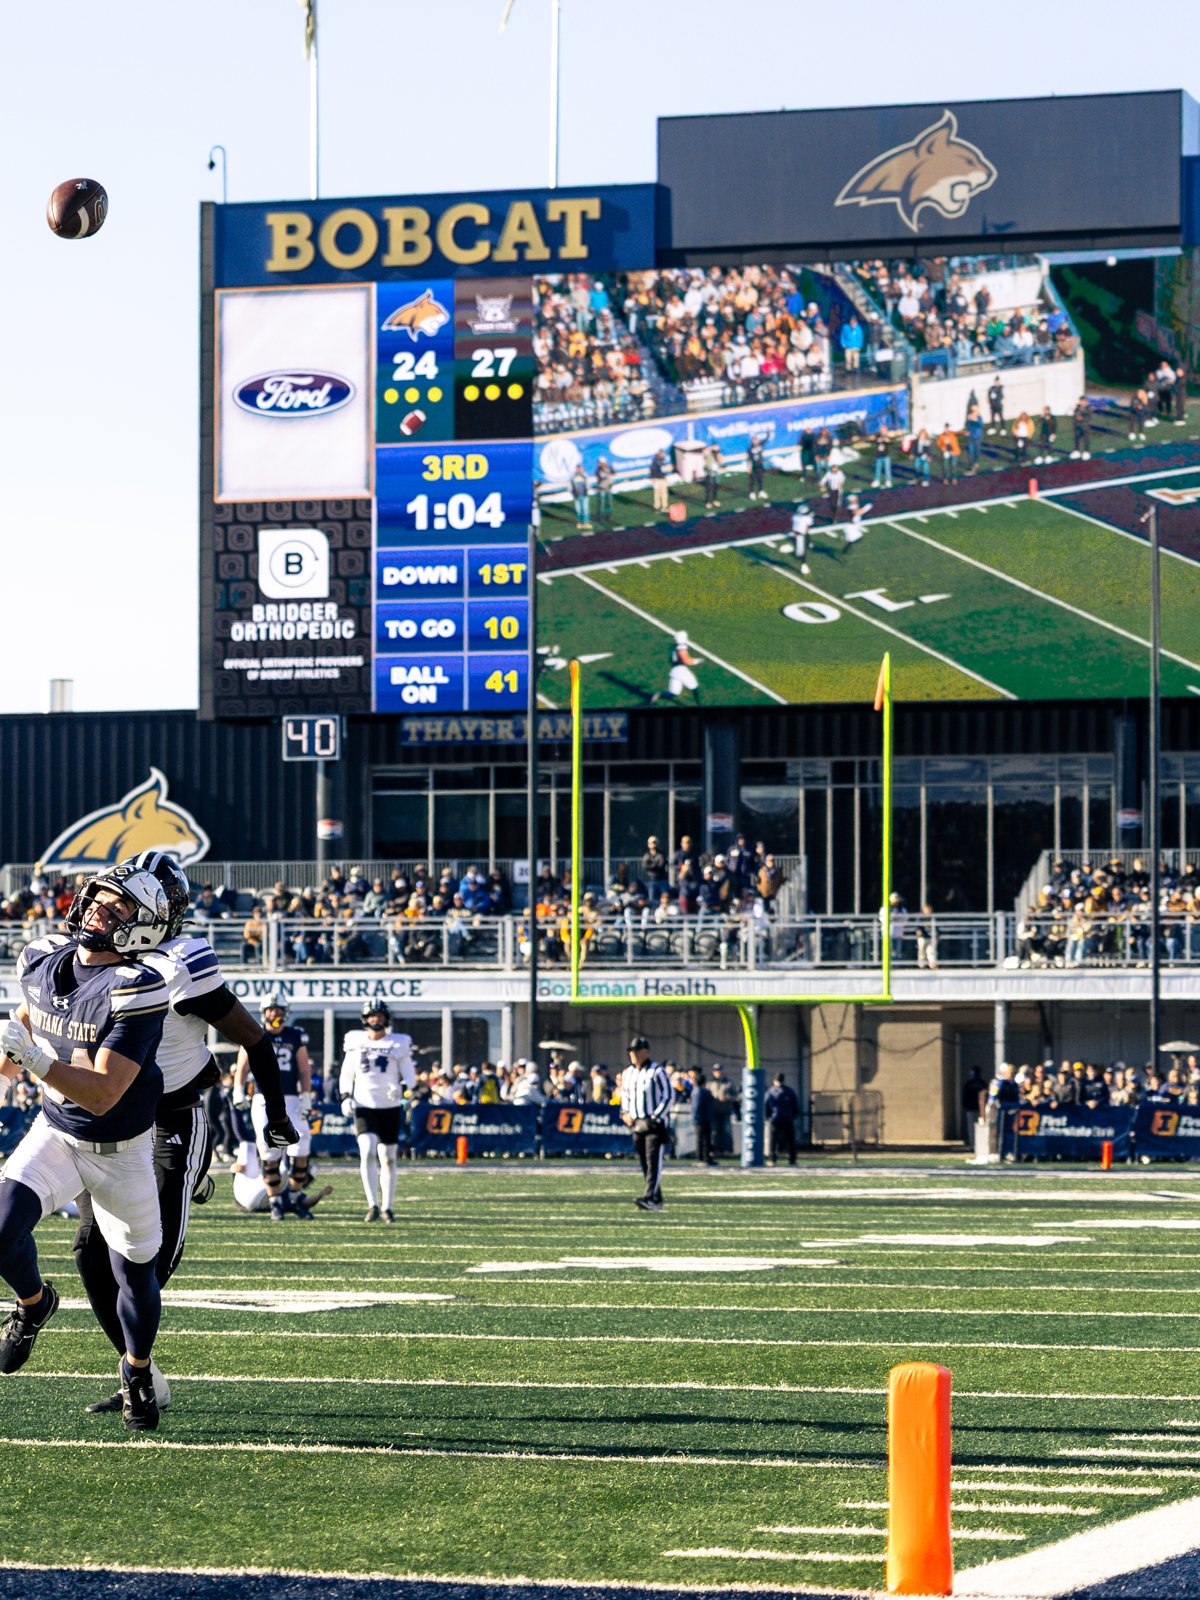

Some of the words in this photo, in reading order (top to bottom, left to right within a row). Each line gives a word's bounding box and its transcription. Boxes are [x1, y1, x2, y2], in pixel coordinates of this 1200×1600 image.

[265, 197, 601, 273] BOBCAT
[392, 351, 438, 381] 24
[471, 348, 517, 378] 27
[256, 375, 333, 410] Ford
[422, 454, 489, 481] 3RD
[406, 492, 505, 531] 1:04
[285, 552, 303, 576] B
[478, 564, 526, 585] 1ST
[383, 566, 457, 586] DOWN
[252, 603, 338, 623] BRIDGER
[231, 620, 354, 642] ORTHOPEDIC
[385, 620, 417, 639] TO
[420, 619, 456, 639] GO
[484, 616, 519, 640] 10
[390, 666, 449, 685] BALL
[485, 670, 518, 693] 41
[401, 686, 437, 704] ON
[286, 719, 336, 756] 40
[403, 718, 515, 742] THAYER
[226, 979, 294, 998] OWN
[303, 978, 422, 997] TERRACE
[643, 977, 717, 997] Health
[66, 1020, 97, 1043] STATE
